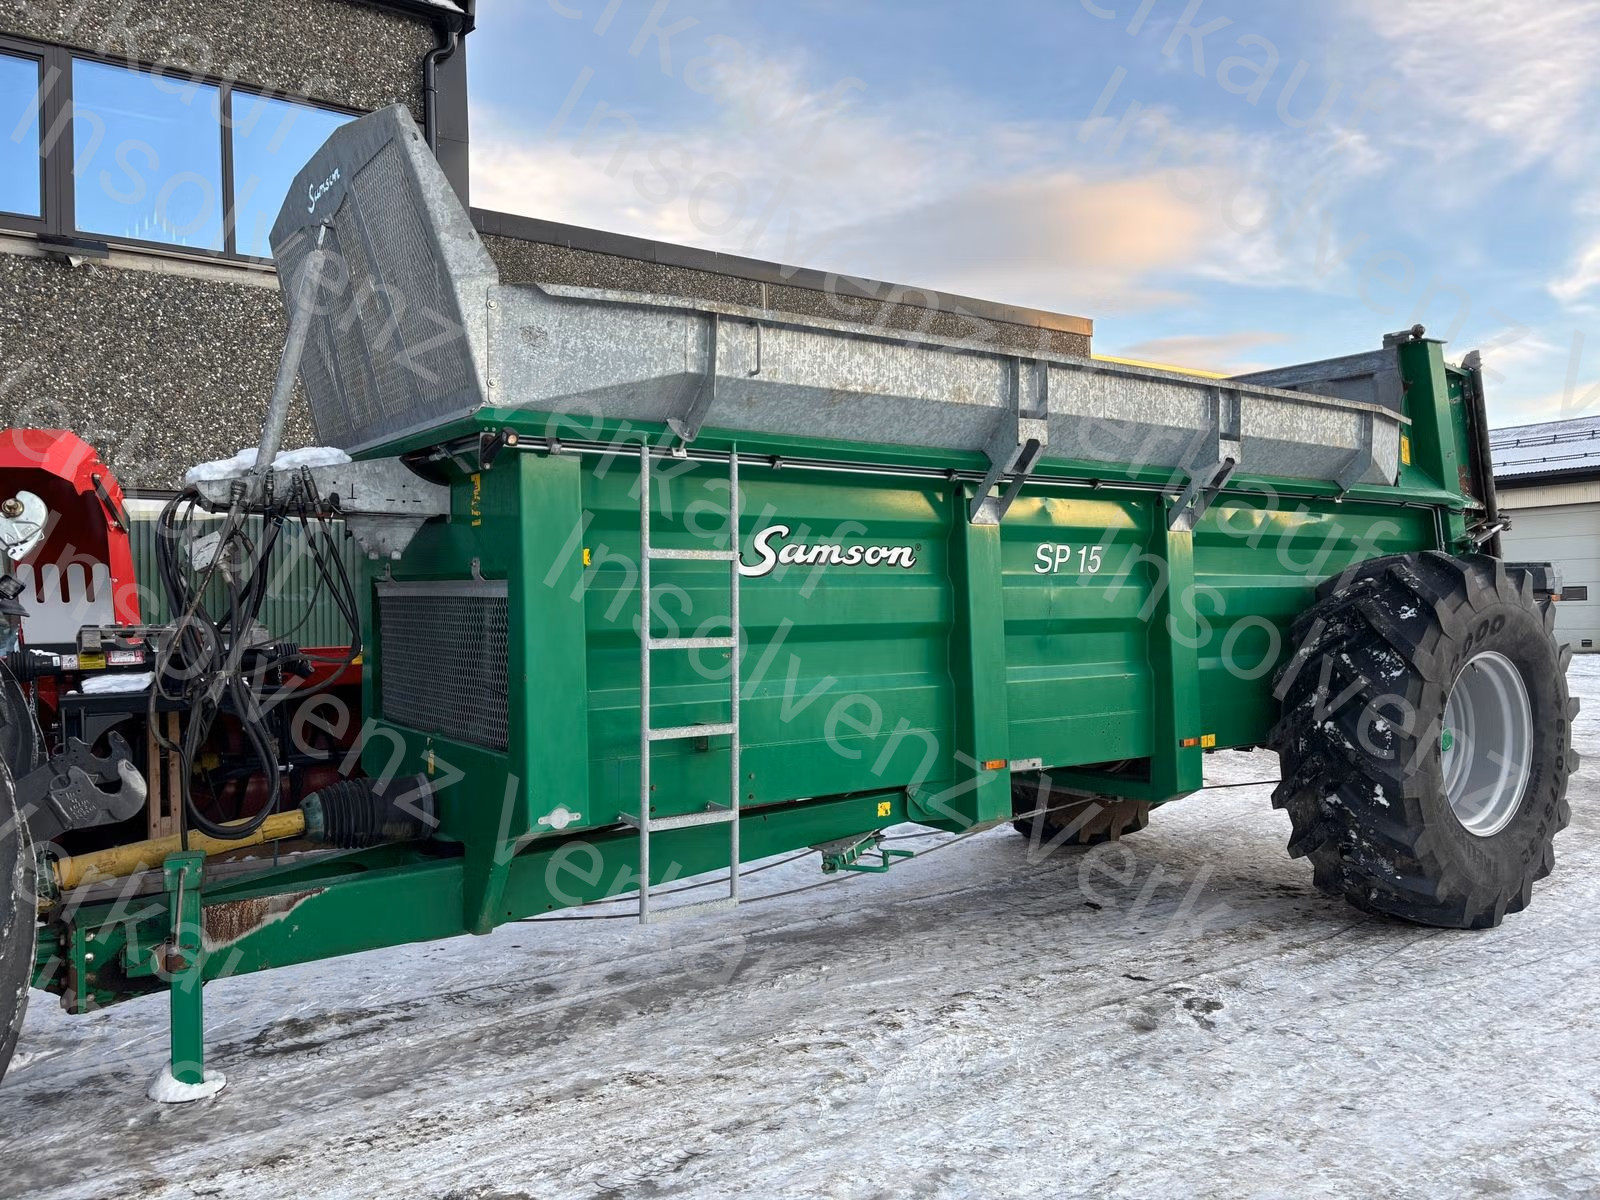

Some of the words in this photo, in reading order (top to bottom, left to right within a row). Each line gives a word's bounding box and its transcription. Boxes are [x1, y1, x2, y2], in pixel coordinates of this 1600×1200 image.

[306, 167, 341, 214] Samson
[738, 524, 916, 577] Samson
[1034, 543, 1071, 574] SP
[1077, 545, 1103, 574] 15
